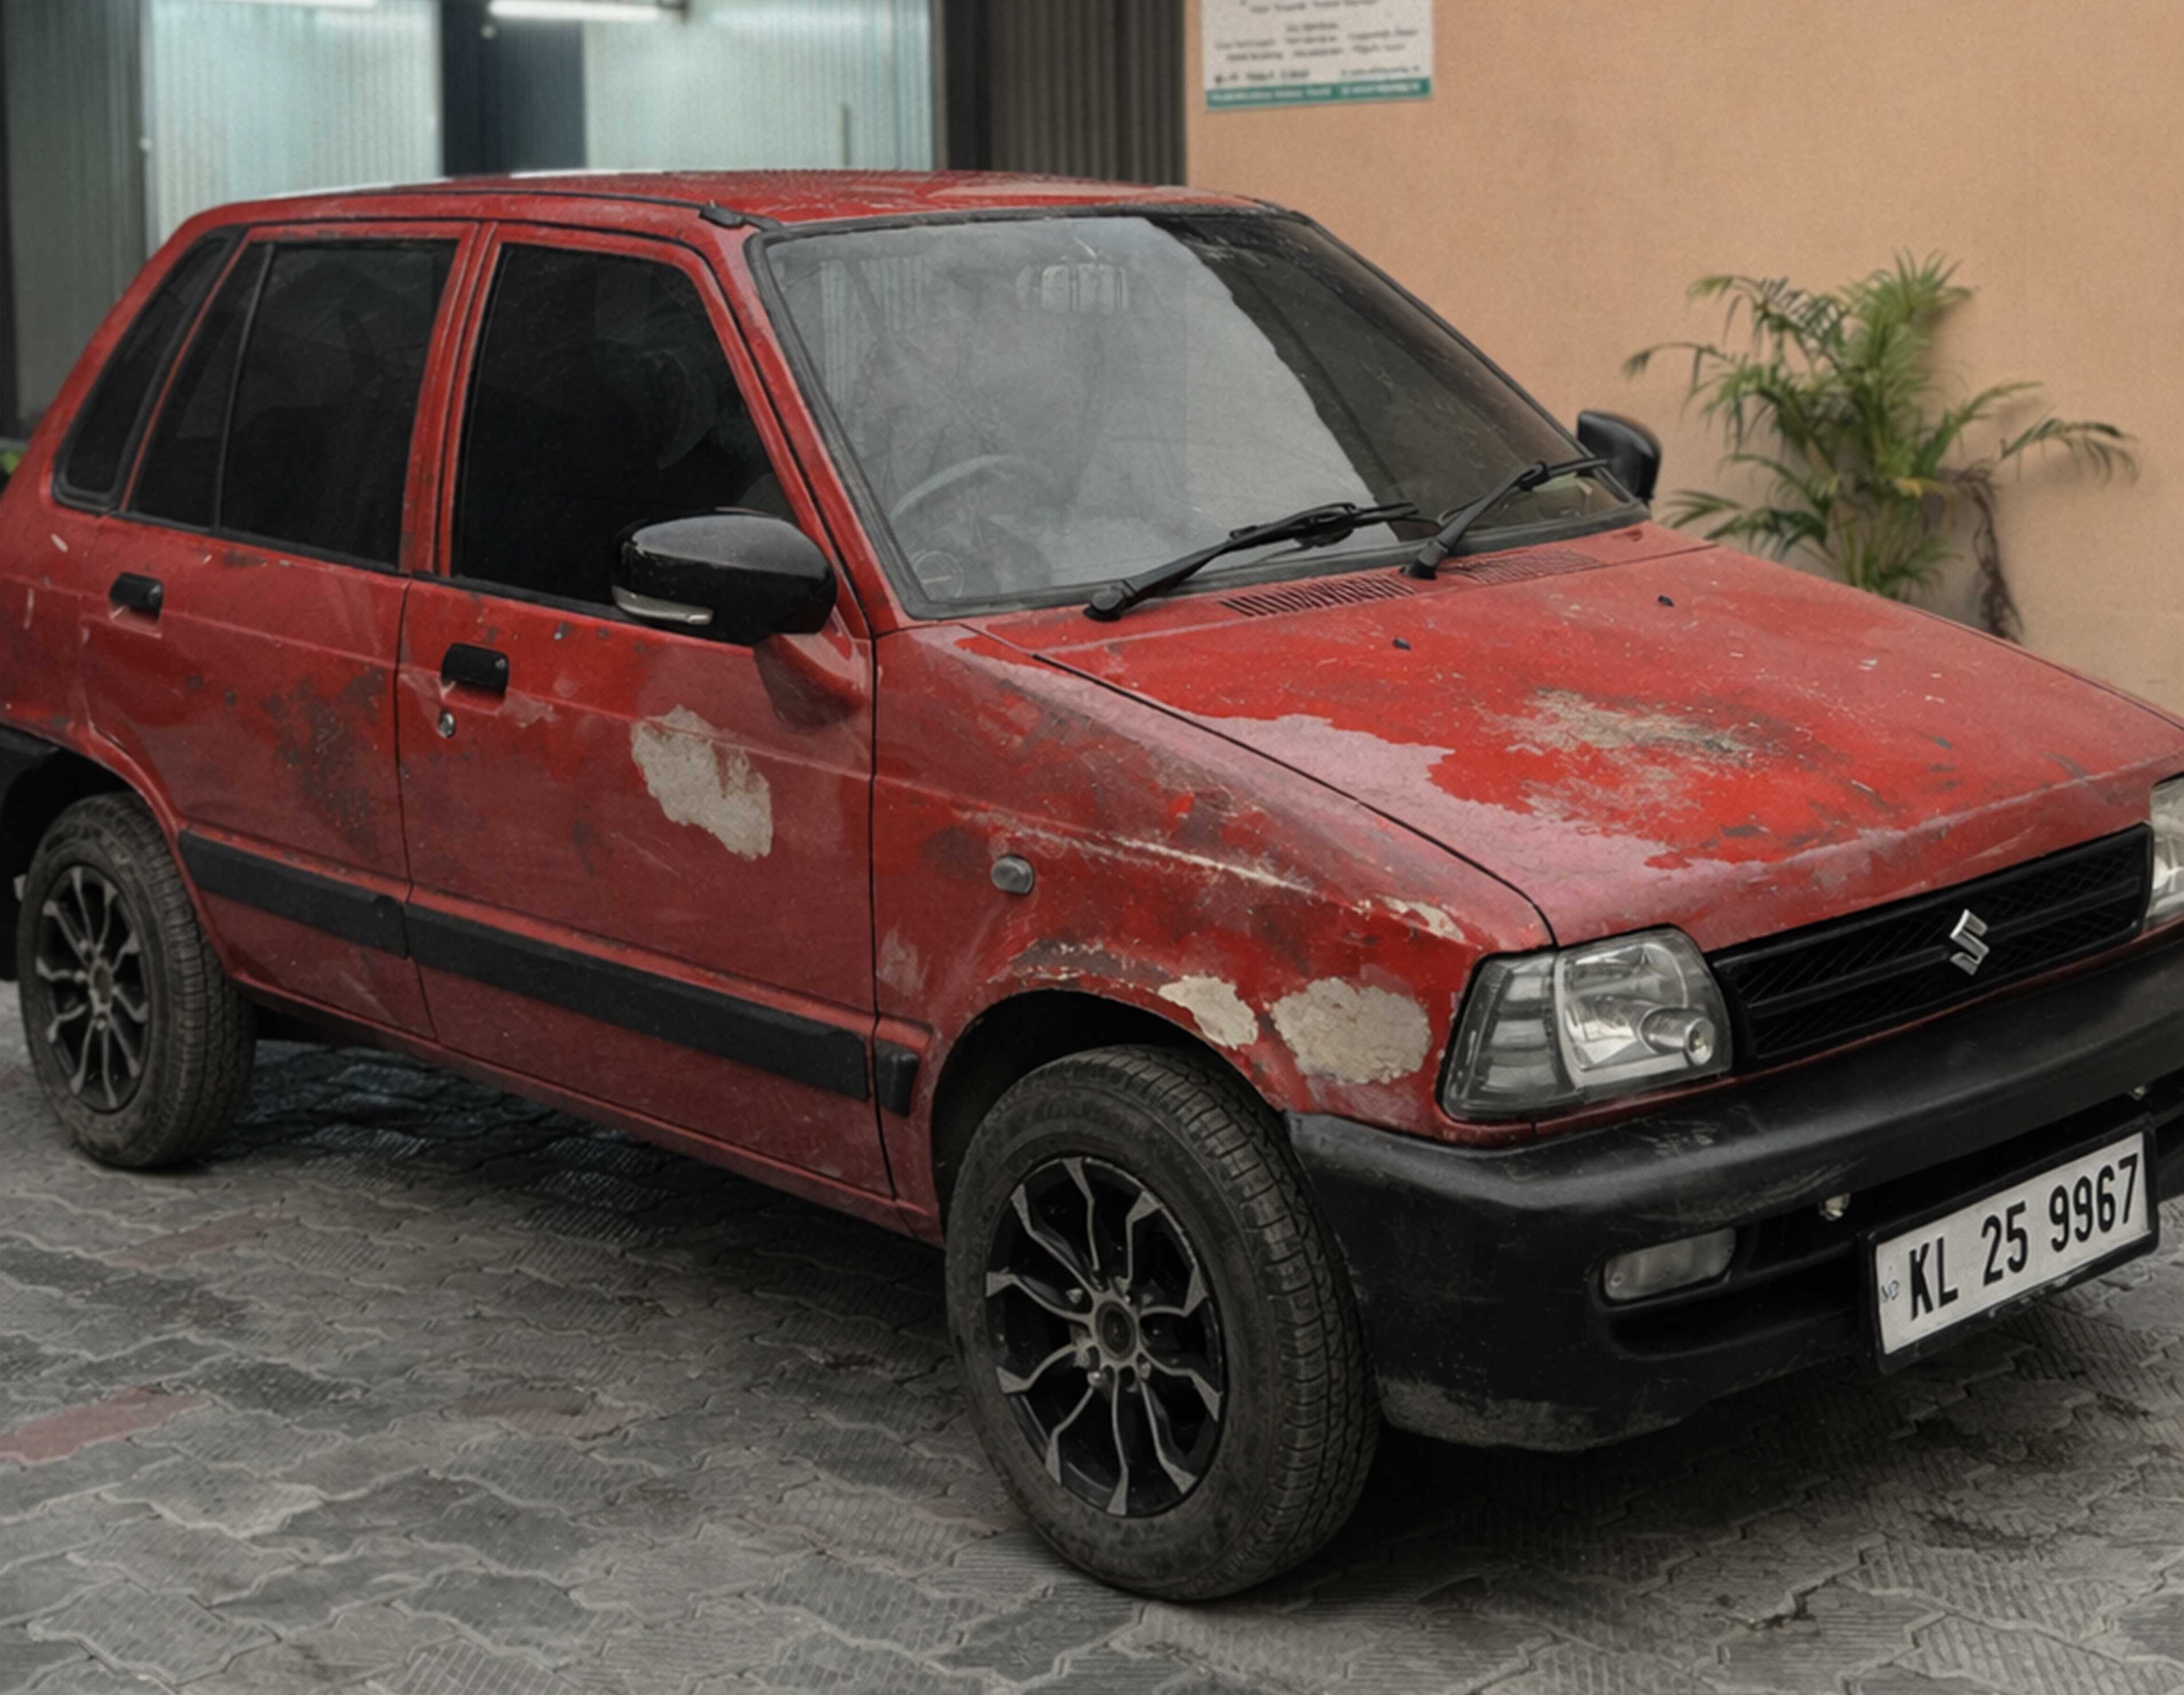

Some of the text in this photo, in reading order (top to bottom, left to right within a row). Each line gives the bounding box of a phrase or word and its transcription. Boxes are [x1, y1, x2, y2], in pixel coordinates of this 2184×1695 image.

[1909, 1153, 2139, 1320] KL 25 9967
